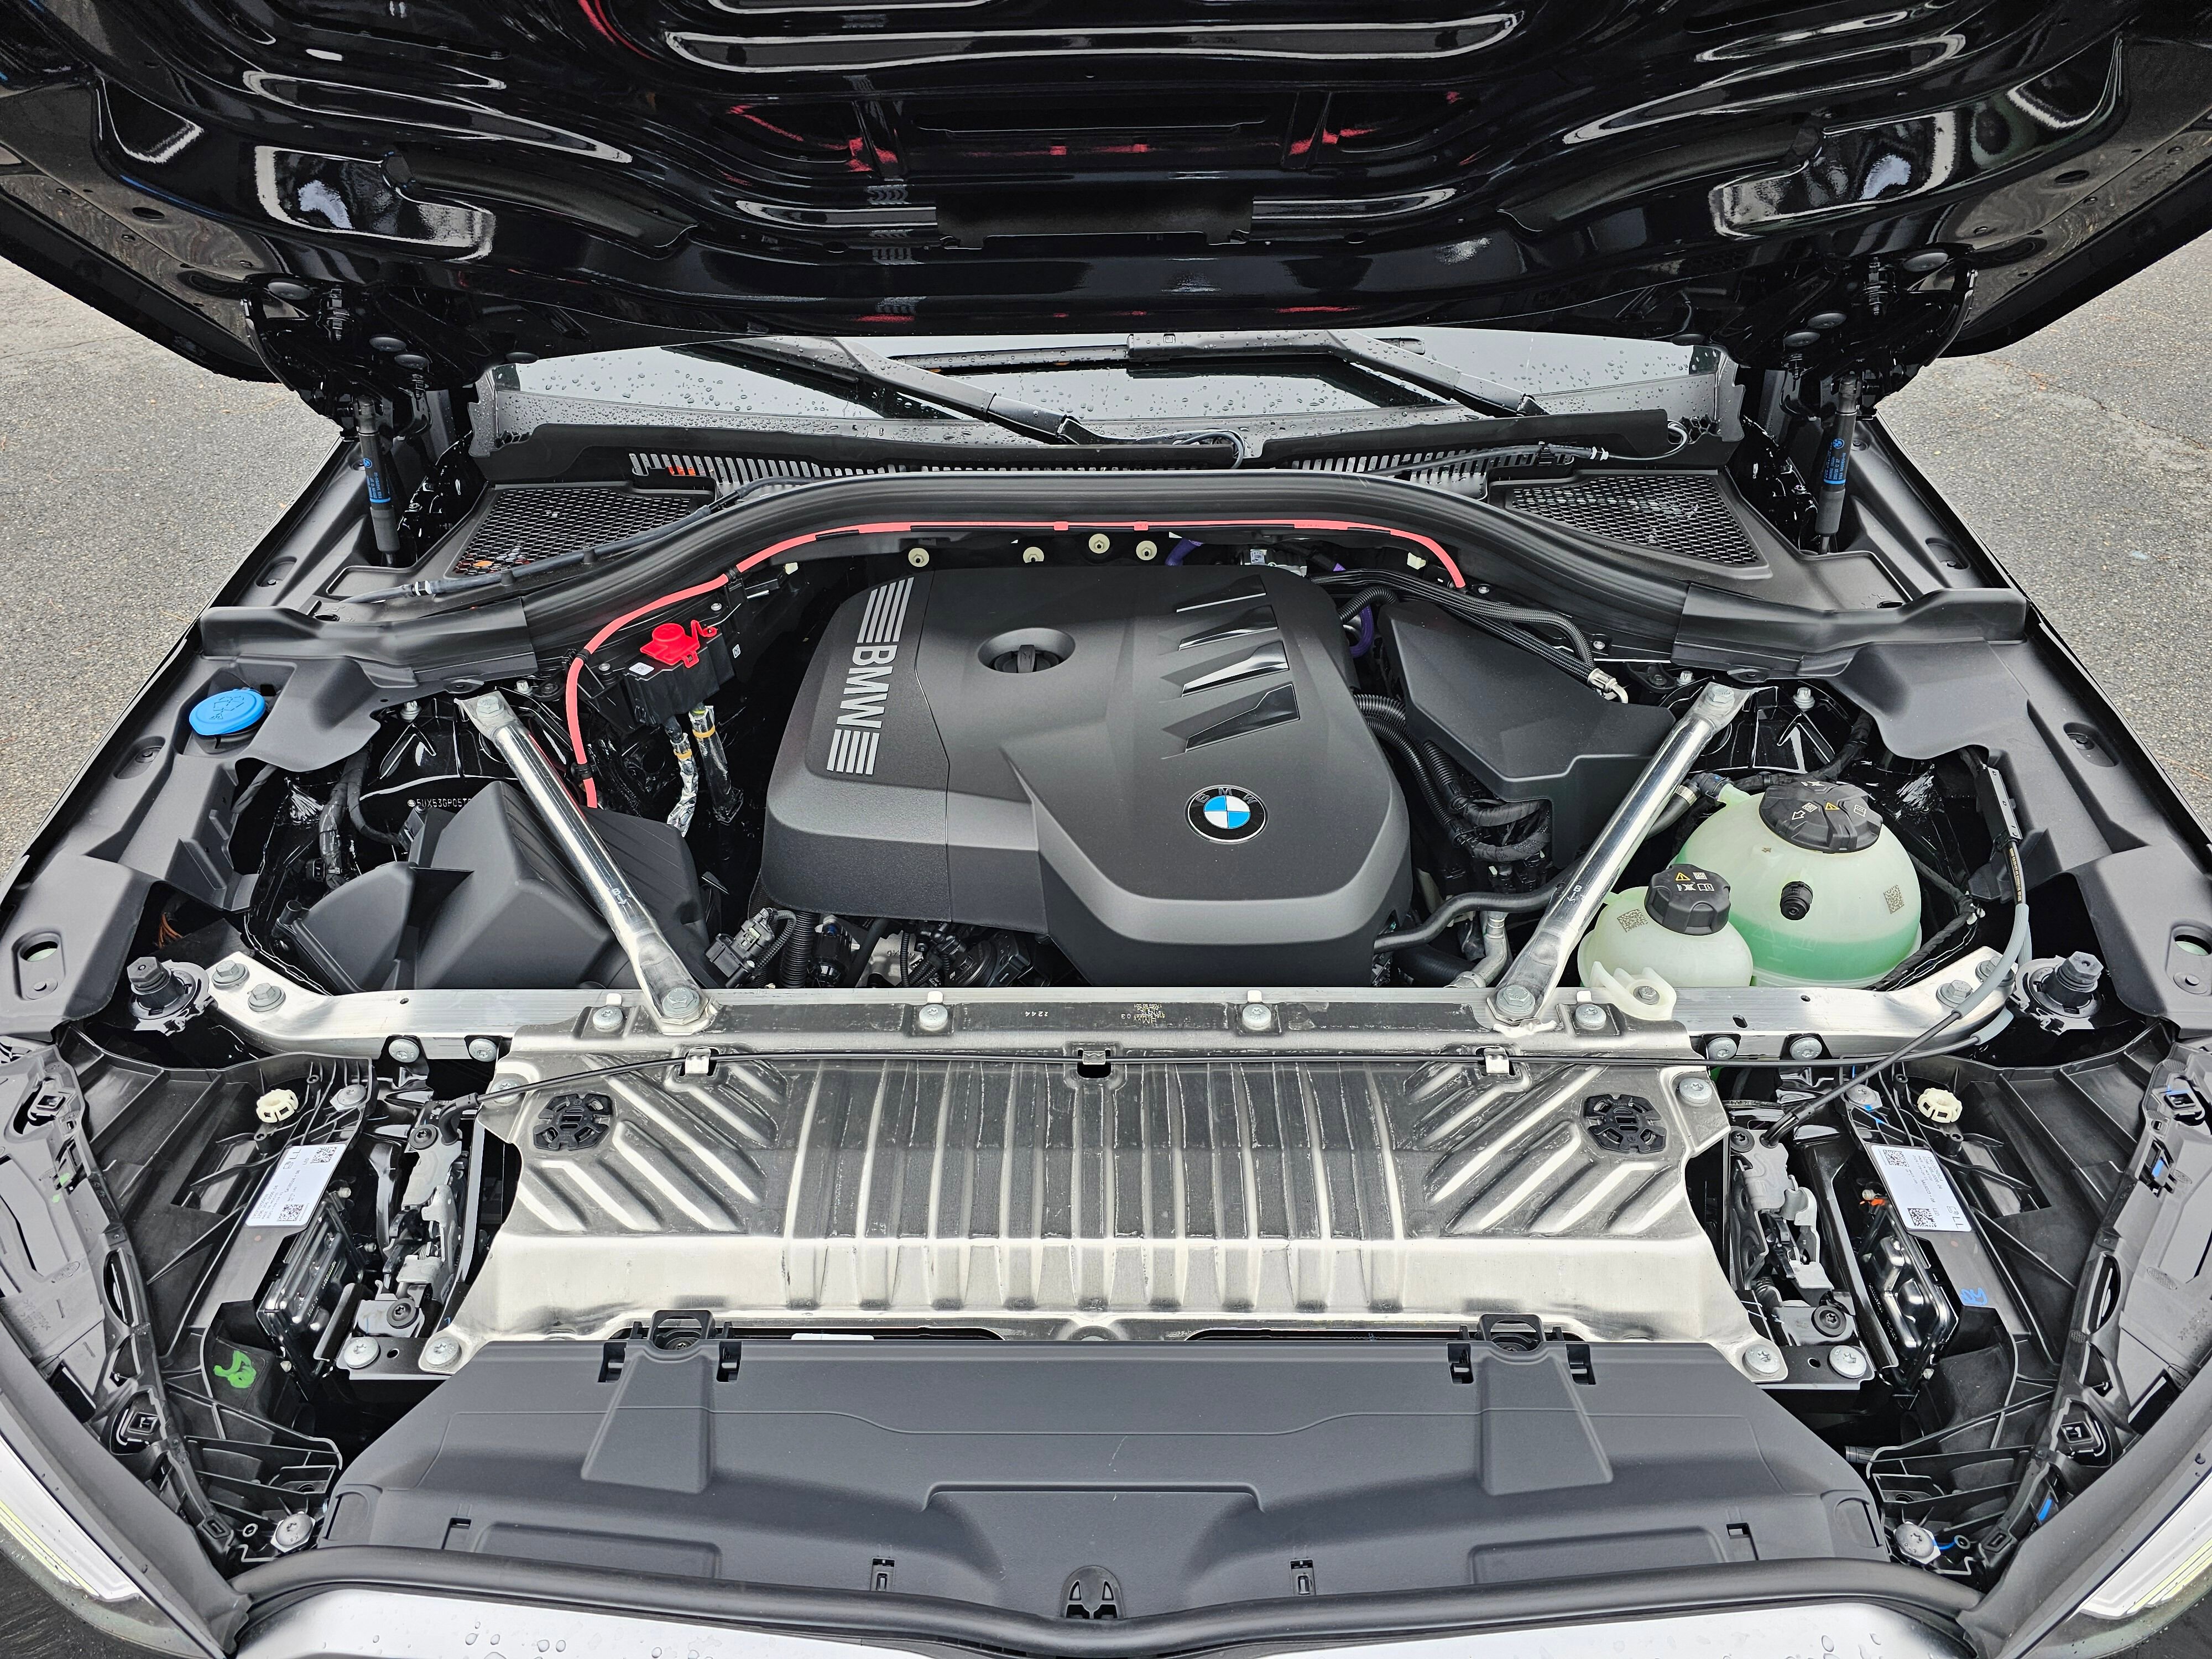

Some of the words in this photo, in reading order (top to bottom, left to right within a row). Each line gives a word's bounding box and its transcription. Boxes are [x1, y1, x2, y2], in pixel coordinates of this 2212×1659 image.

[837, 645, 898, 728] BMW
[1196, 788, 1258, 804] BMW
[289, 1148, 302, 1159] LL
[1952, 1216, 1966, 1229] LL
